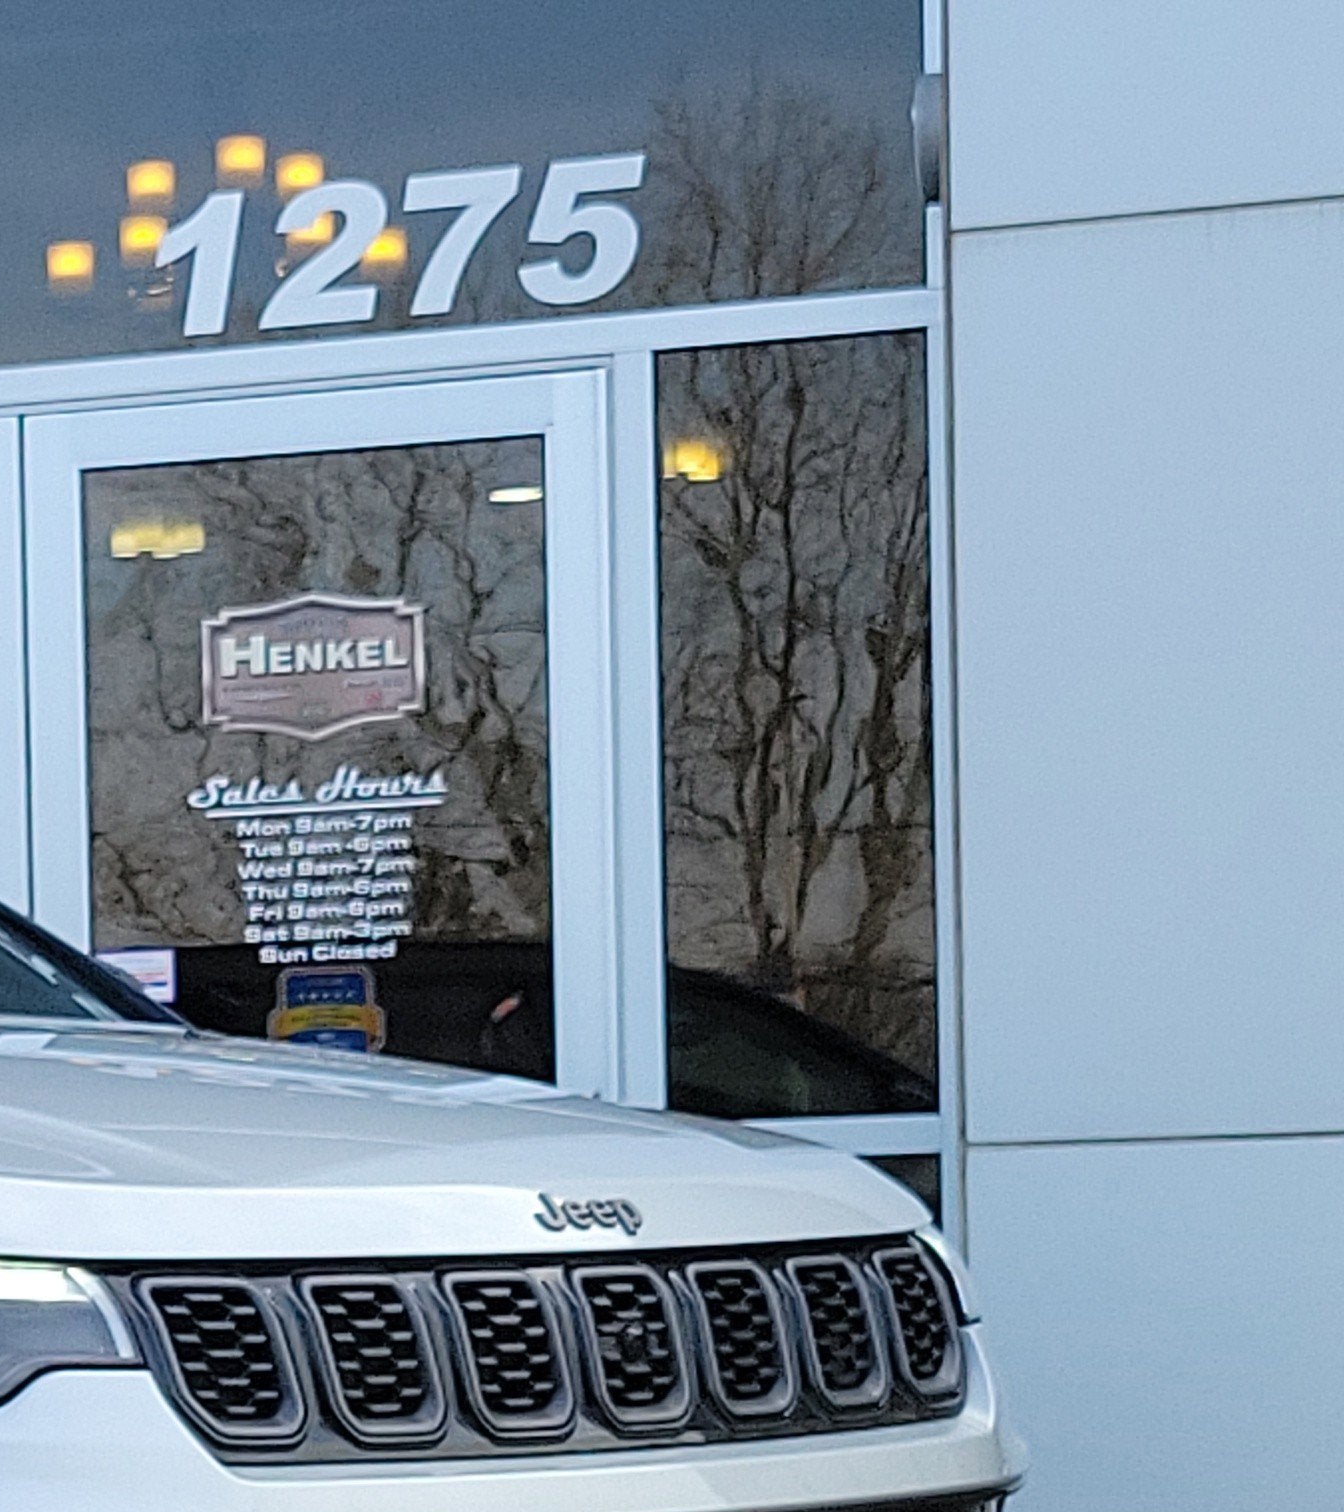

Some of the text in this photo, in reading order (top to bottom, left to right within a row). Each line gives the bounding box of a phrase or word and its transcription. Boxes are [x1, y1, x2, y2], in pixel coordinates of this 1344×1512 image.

[155, 152, 646, 338] 1275
[219, 634, 409, 678] HENKEL
[187, 764, 449, 808] Sales Hours
[236, 814, 412, 838] Mon 9am-7pm
[239, 842, 284, 858] Tue
[237, 861, 293, 880] Wed
[242, 885, 288, 900] Thu
[249, 903, 283, 921] Fri
[244, 924, 290, 943] Sat
[259, 939, 398, 964] Sun Closed
[534, 1192, 643, 1236] Jeep
